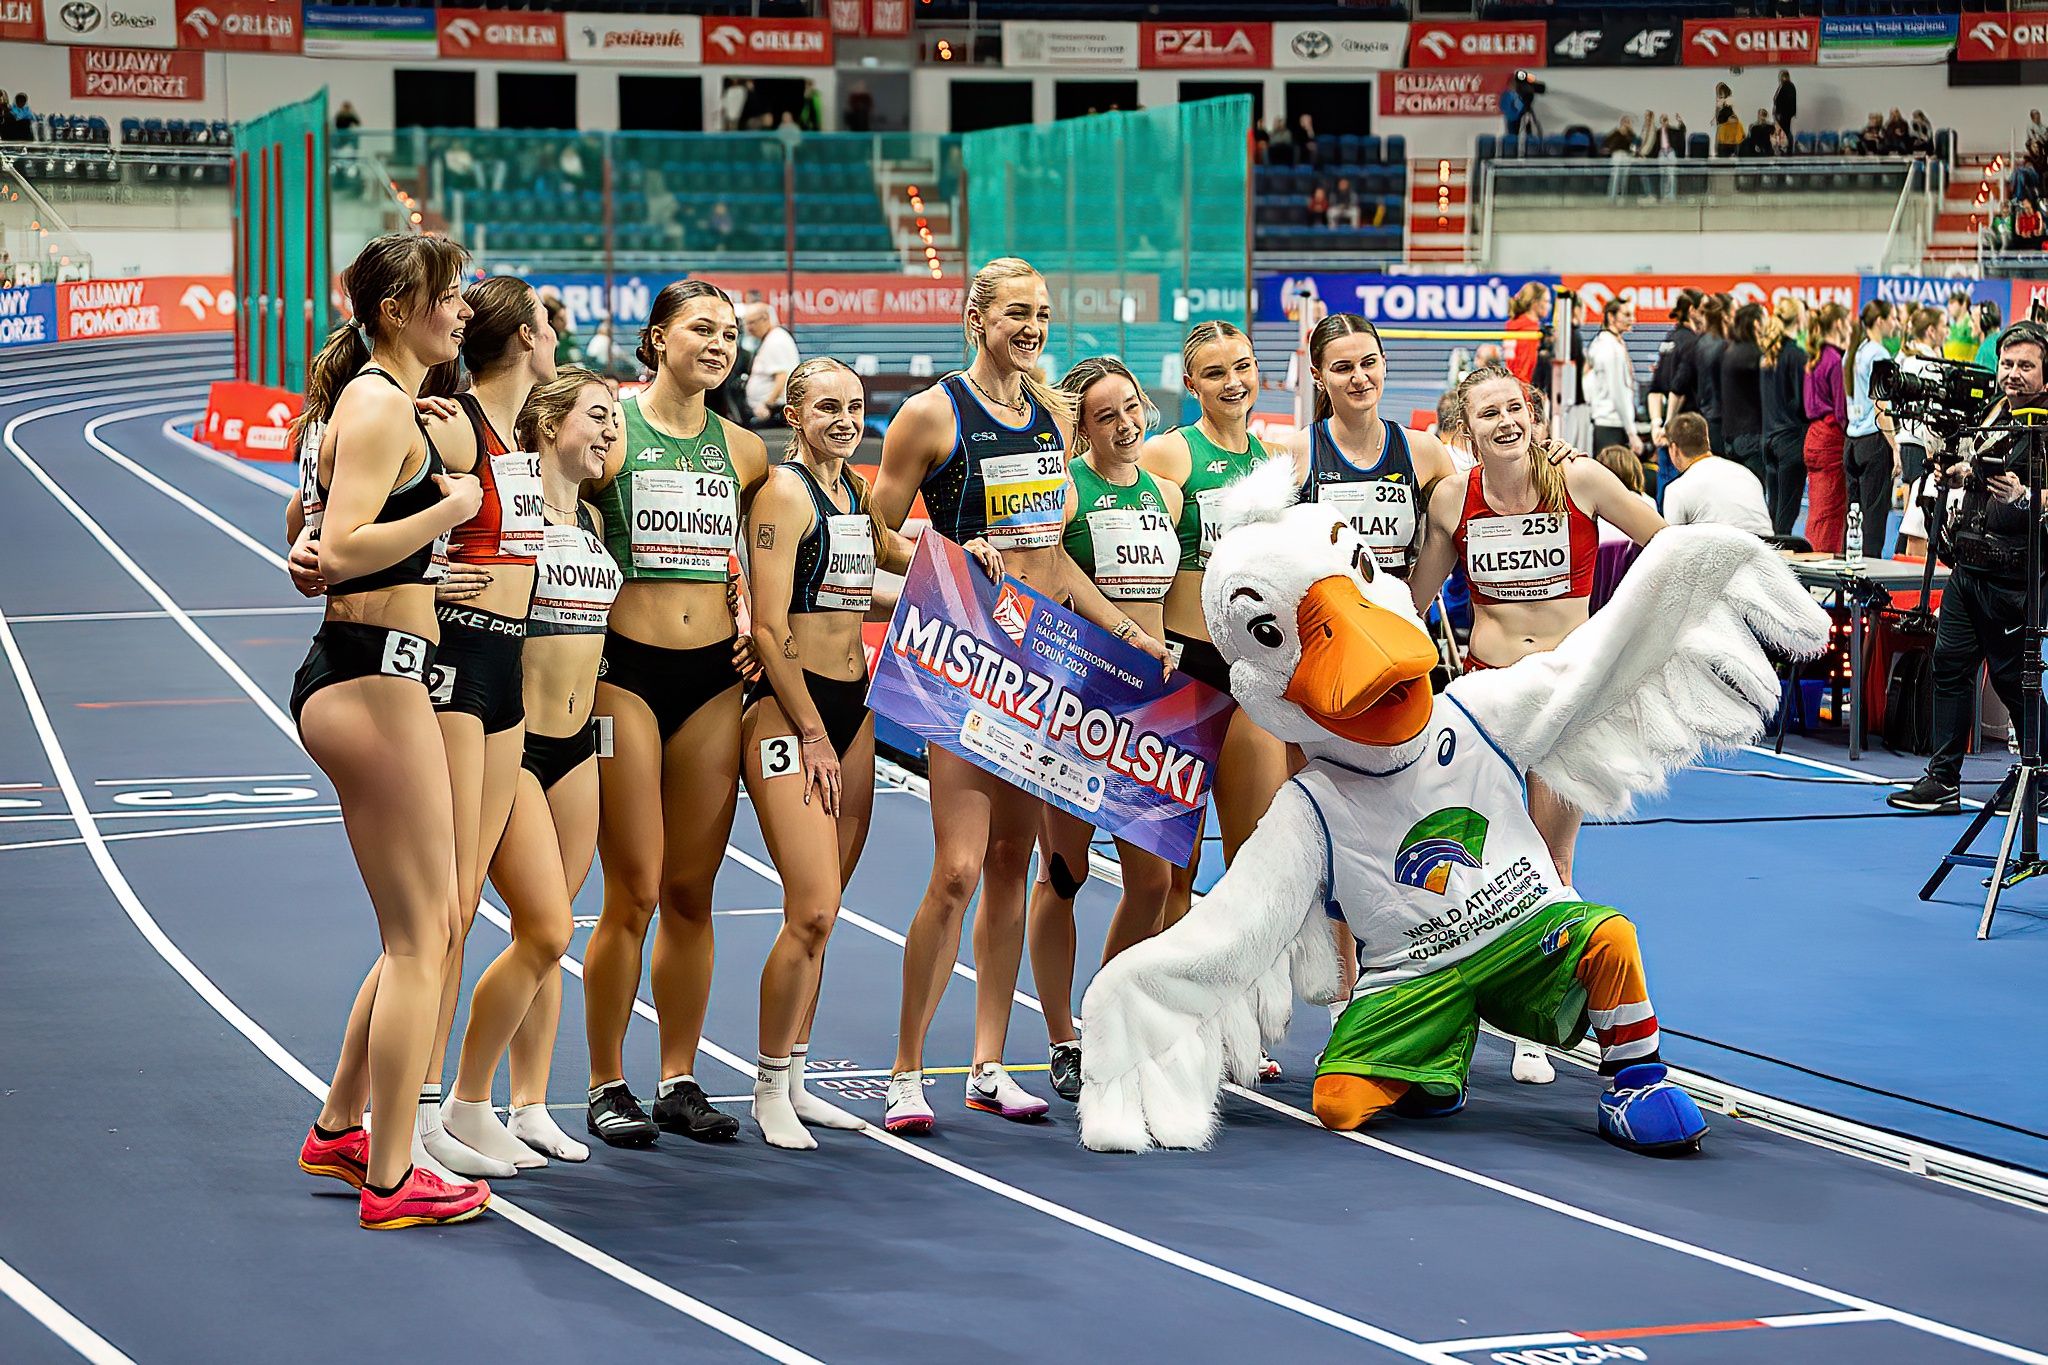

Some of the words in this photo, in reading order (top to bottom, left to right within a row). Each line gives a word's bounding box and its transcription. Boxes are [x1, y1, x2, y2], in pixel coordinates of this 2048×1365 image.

[222, 15, 293, 37] ORLEN
[484, 25, 557, 46] ORLEN
[749, 30, 823, 51] ORLEN
[1154, 29, 1255, 55] PZLA
[1460, 34, 1536, 55] ORLEN
[1554, 30, 1603, 58] 4F
[1623, 29, 1674, 58] 4F
[1735, 31, 1809, 51] ORLEN
[86, 51, 171, 72] KUJAWY
[86, 75, 188, 97] POMORZE
[1395, 74, 1481, 93] KUJAWY
[1395, 94, 1497, 113] POMORZE
[69, 281, 144, 309] KUJAWY
[537, 277, 650, 321] ORUŃ
[769, 288, 880, 315] HALOWE
[883, 287, 964, 315] MISTRZ
[1356, 277, 1509, 321] TORUŃ
[1877, 279, 1975, 302] KUJAWY
[70, 305, 160, 337] POMORZE
[636, 447, 666, 463] 4F
[1037, 456, 1062, 475] 326
[1206, 460, 1228, 473] 4F
[1318, 472, 1341, 481] esa
[696, 477, 729, 498] 160
[1375, 486, 1407, 504] 328
[991, 489, 1066, 516] LIGARSKA
[1094, 495, 1118, 508] 4F
[637, 508, 732, 536] ODOLIŃSKA
[1139, 514, 1168, 531] 174
[1522, 516, 1559, 536] 253
[1116, 545, 1164, 565] SURA
[1472, 548, 1565, 573] KLESZNO
[546, 563, 617, 590] NOWAK
[1527, 588, 1549, 597] 2026
[1040, 610, 1053, 628] 70.
[1056, 619, 1078, 641] PZLA
[392, 637, 417, 673] 5
[1032, 637, 1065, 665] TORUŃ
[1065, 656, 1088, 678] 2026
[1035, 624, 1068, 648] HALOWE
[1067, 642, 1116, 676] MISTRZOSTWA
[1117, 669, 1144, 689] POLSKI
[897, 604, 1053, 728] MISTRZ
[1049, 689, 1205, 805] POLSKI
[769, 740, 790, 772] 3
[1402, 908, 1463, 939] WORLD
[1464, 856, 1532, 916] ATHLETICS
[1459, 870, 1541, 933] CHAMPIONSHIPS
[805, 1060, 859, 1070] 20
[838, 1089, 888, 1100] 00
